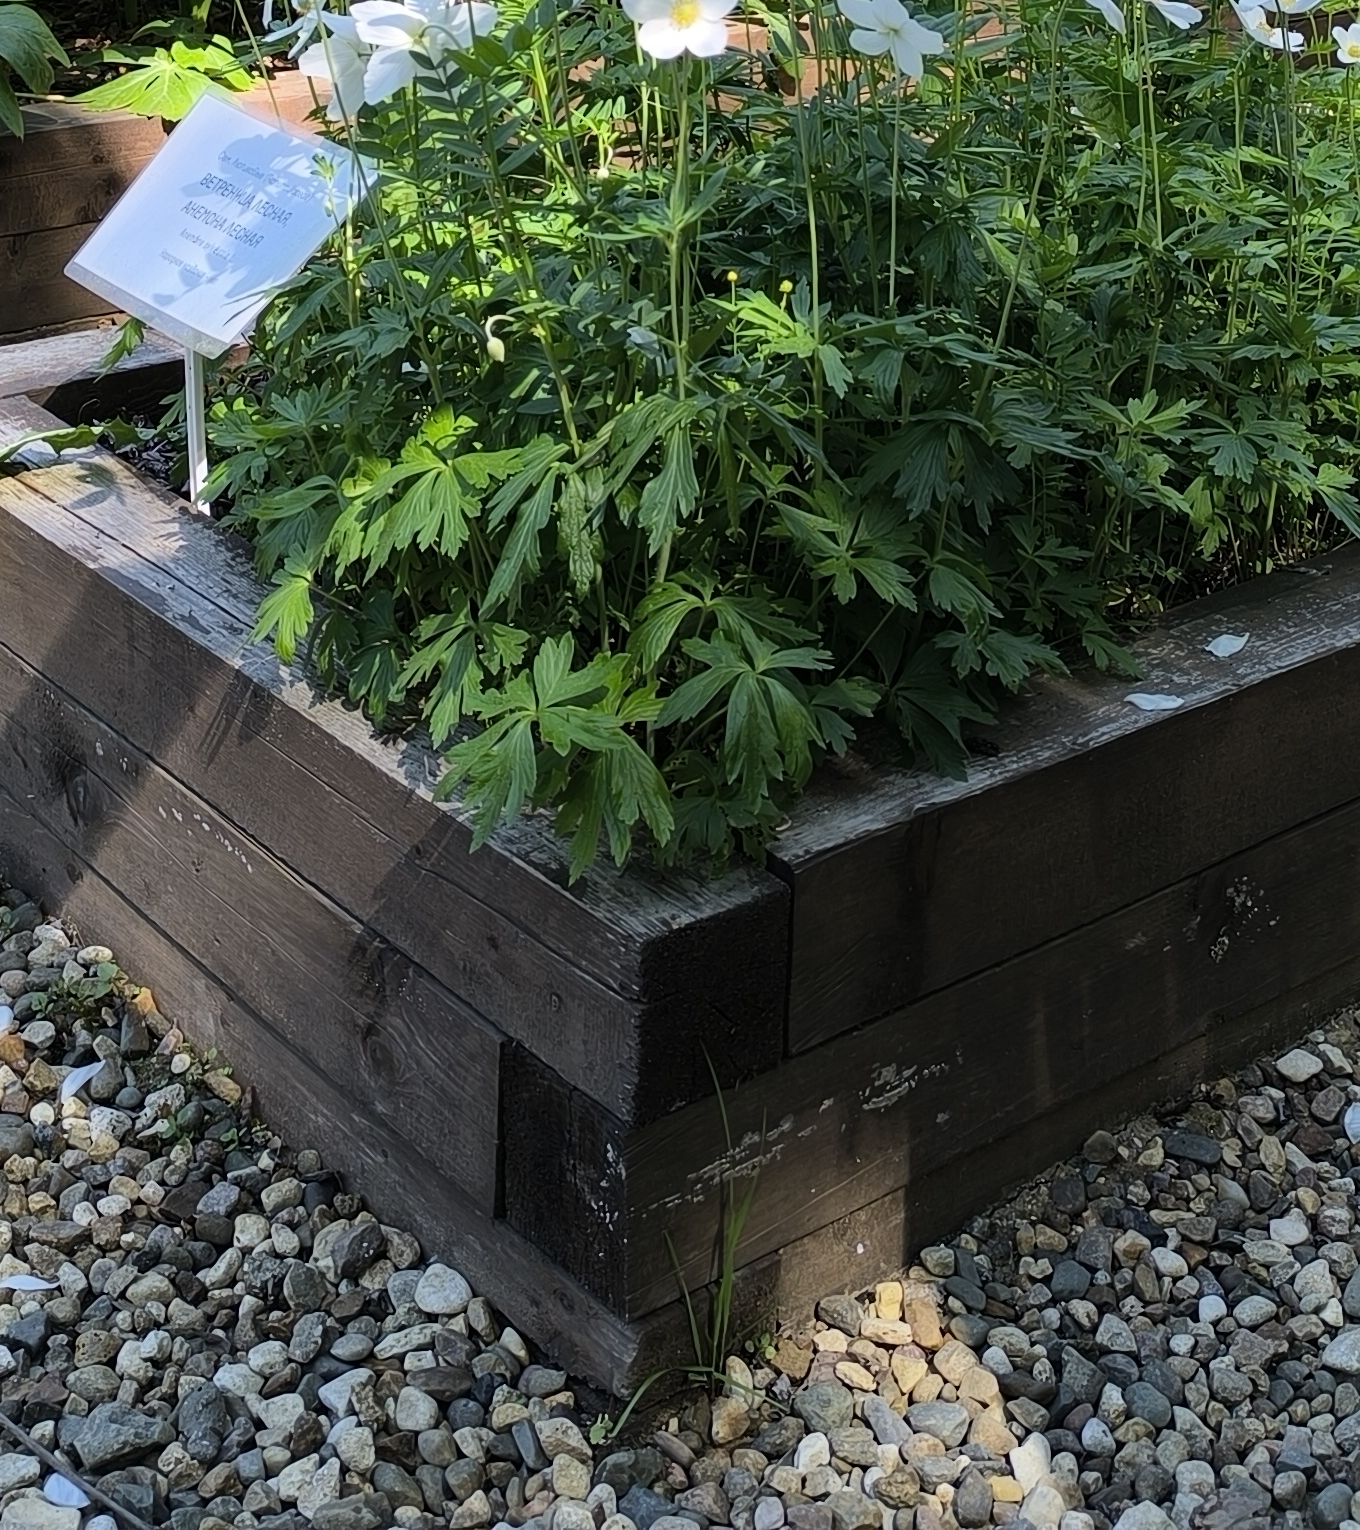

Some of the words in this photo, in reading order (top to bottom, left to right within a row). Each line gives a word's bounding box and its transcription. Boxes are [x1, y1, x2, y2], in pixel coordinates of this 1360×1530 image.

[200, 172, 256, 209] ВЕТРЕНИЦА
[180, 200, 228, 231] АНЕМОНА
[222, 221, 265, 248] ЛЕСНАЯ
